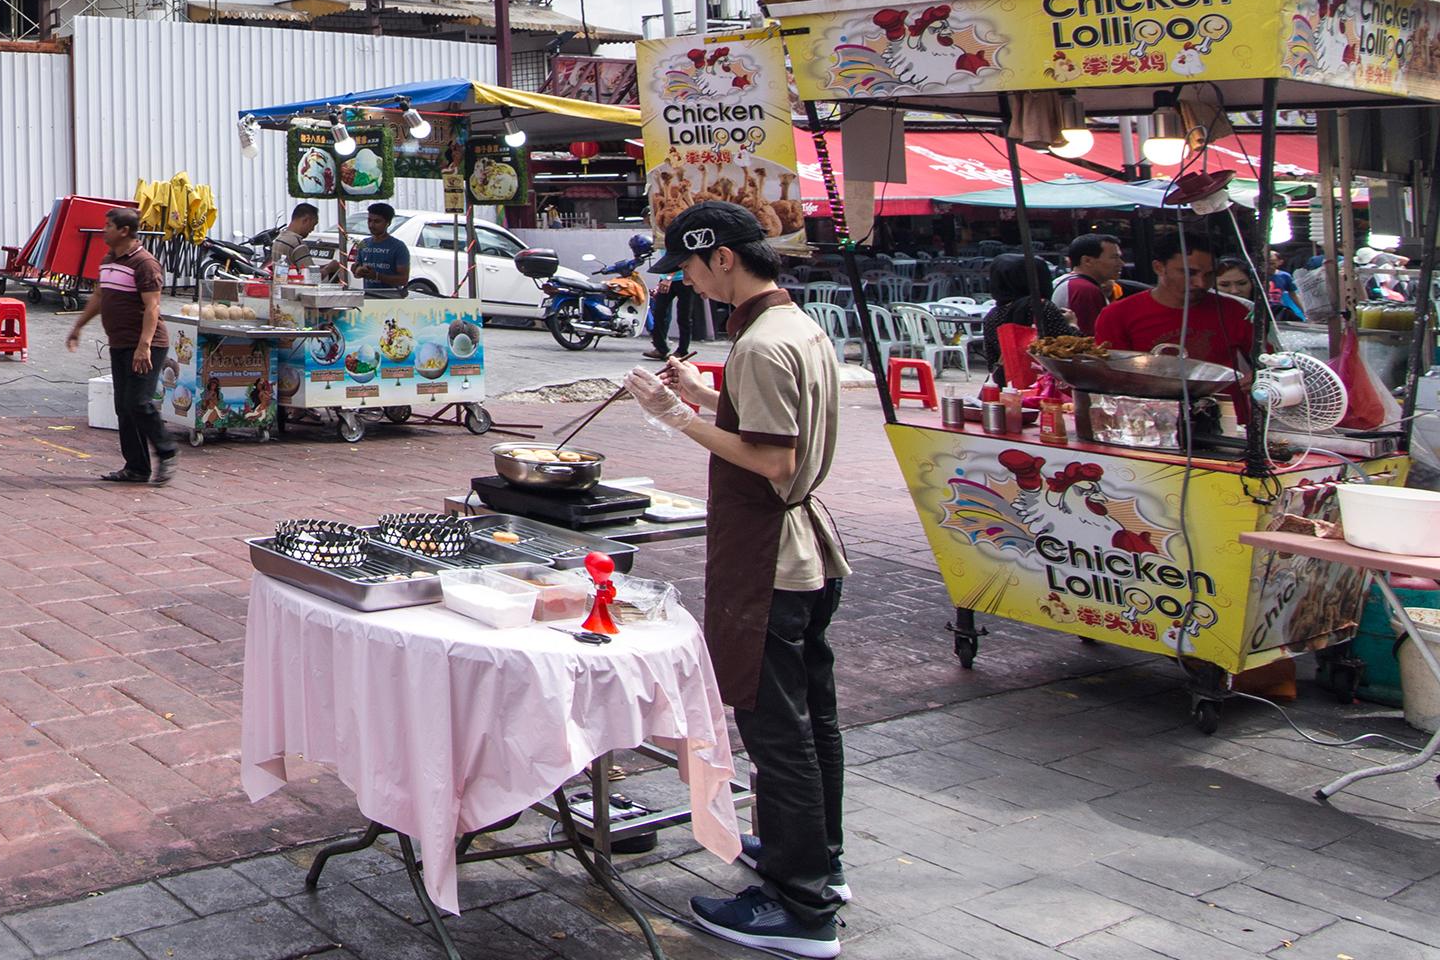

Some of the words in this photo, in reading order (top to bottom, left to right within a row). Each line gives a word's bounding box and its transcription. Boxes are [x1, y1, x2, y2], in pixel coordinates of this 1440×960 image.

[1052, 13, 1232, 57] Lollipop
[1081, 51, 1168, 77] 拳头鸡
[663, 102, 764, 124] Chicken
[668, 125, 766, 152] Lollipop
[1035, 533, 1217, 597] Chicken
